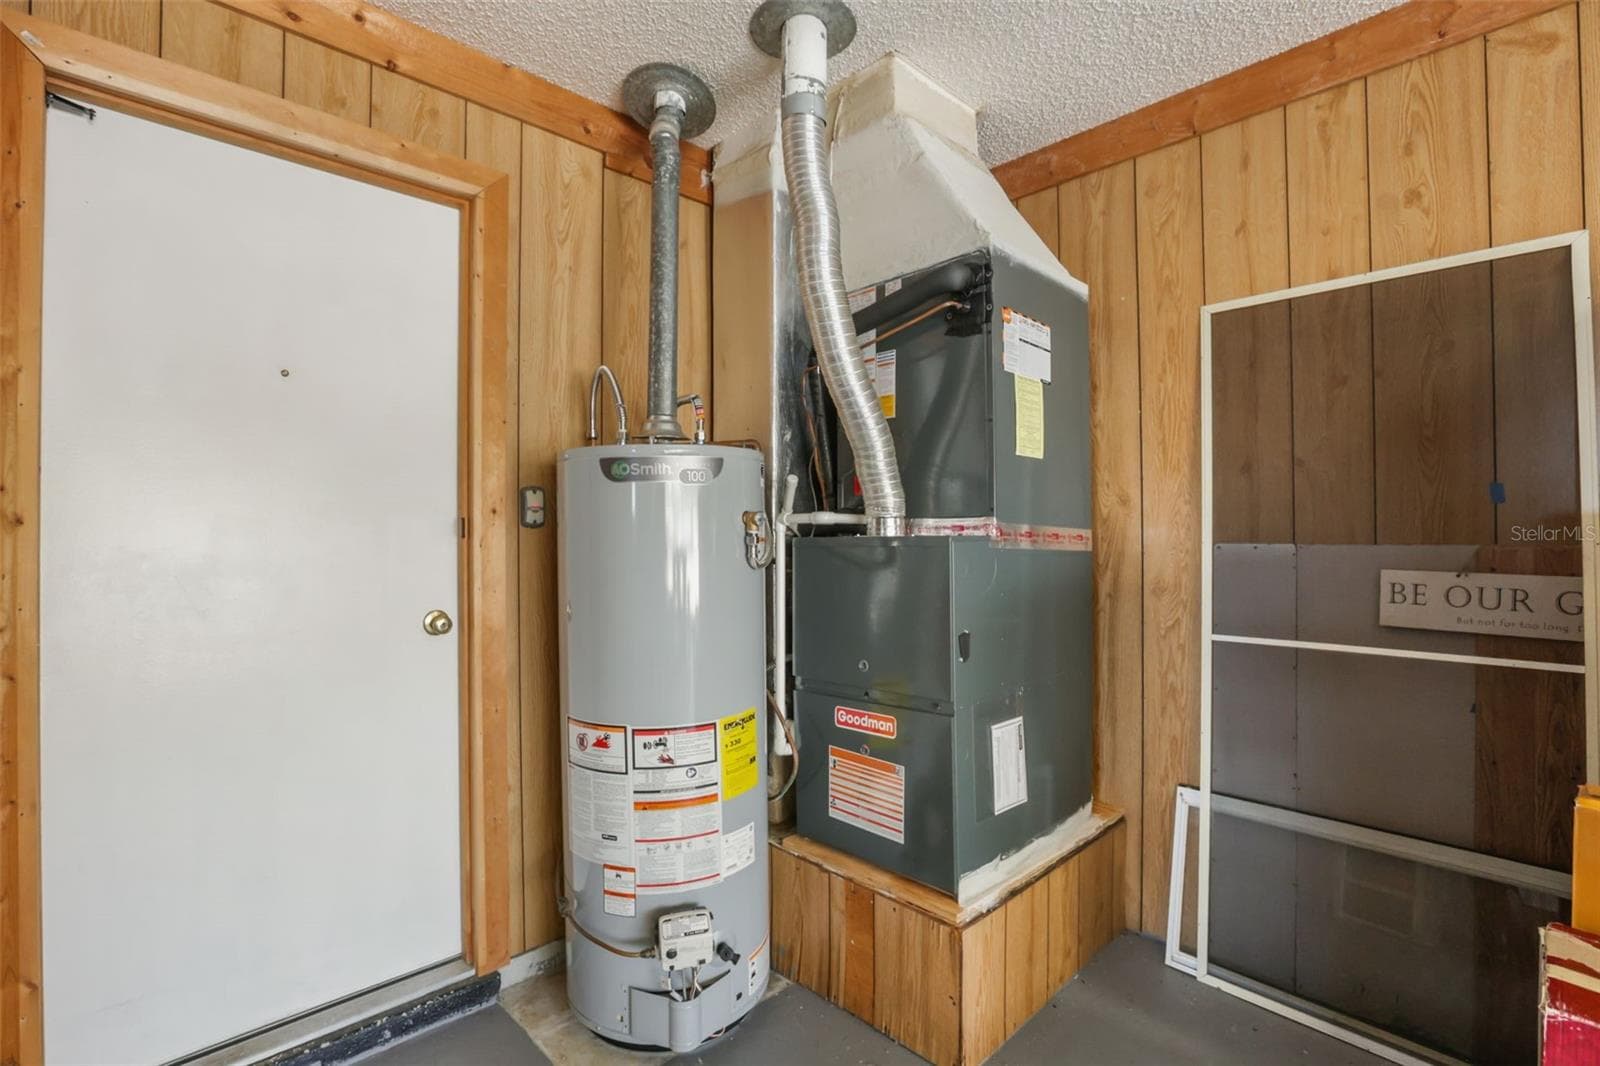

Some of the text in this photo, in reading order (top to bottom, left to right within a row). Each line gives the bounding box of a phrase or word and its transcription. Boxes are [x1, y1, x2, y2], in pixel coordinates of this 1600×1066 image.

[1388, 582, 1428, 606] BE
[1444, 585, 1534, 613] OUR
[1478, 618, 1496, 627] not
[1499, 618, 1516, 628] for
[838, 710, 894, 732] Goodman
